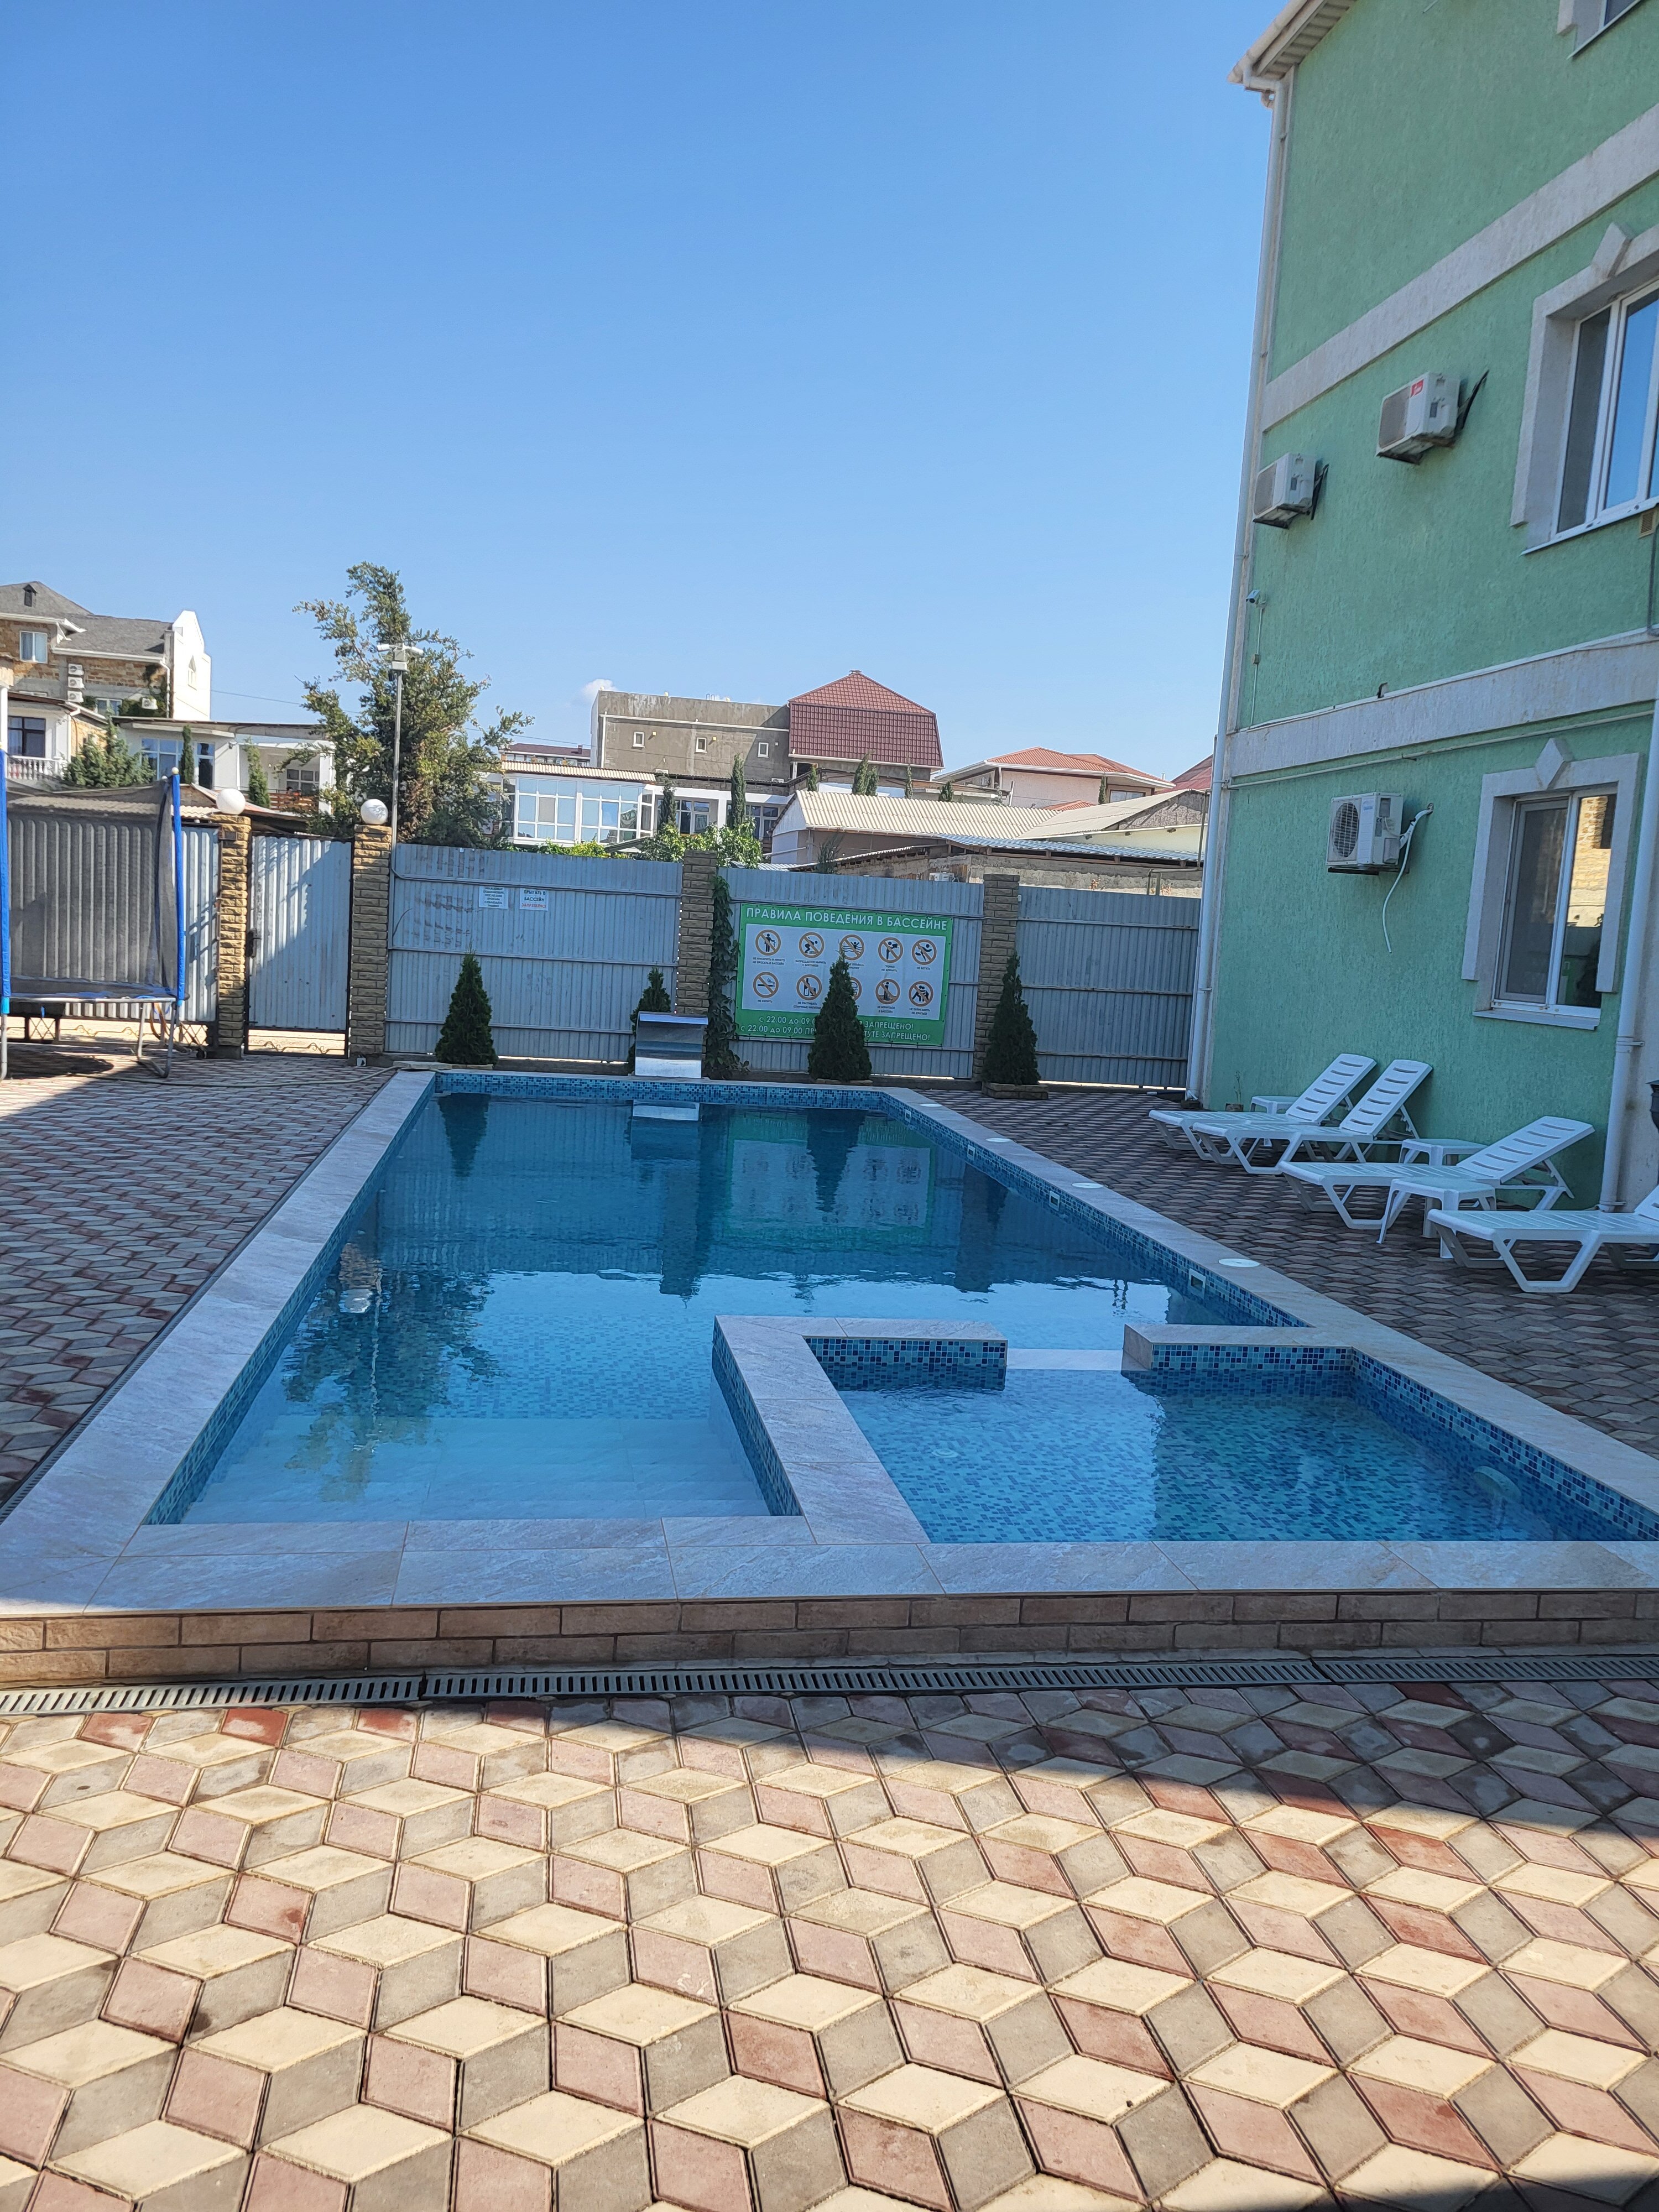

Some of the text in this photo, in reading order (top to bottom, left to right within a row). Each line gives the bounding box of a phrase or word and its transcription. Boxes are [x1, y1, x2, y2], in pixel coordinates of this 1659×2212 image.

[747, 907, 947, 930] ПРАВИЛА ПОВЕДЕНИЯ В БАССЕЙНЕ
[864, 1021, 914, 1030] ЗАПРЕЩЕНО!
[881, 1031, 930, 1041] ЗАПРЕЩЕНО!
